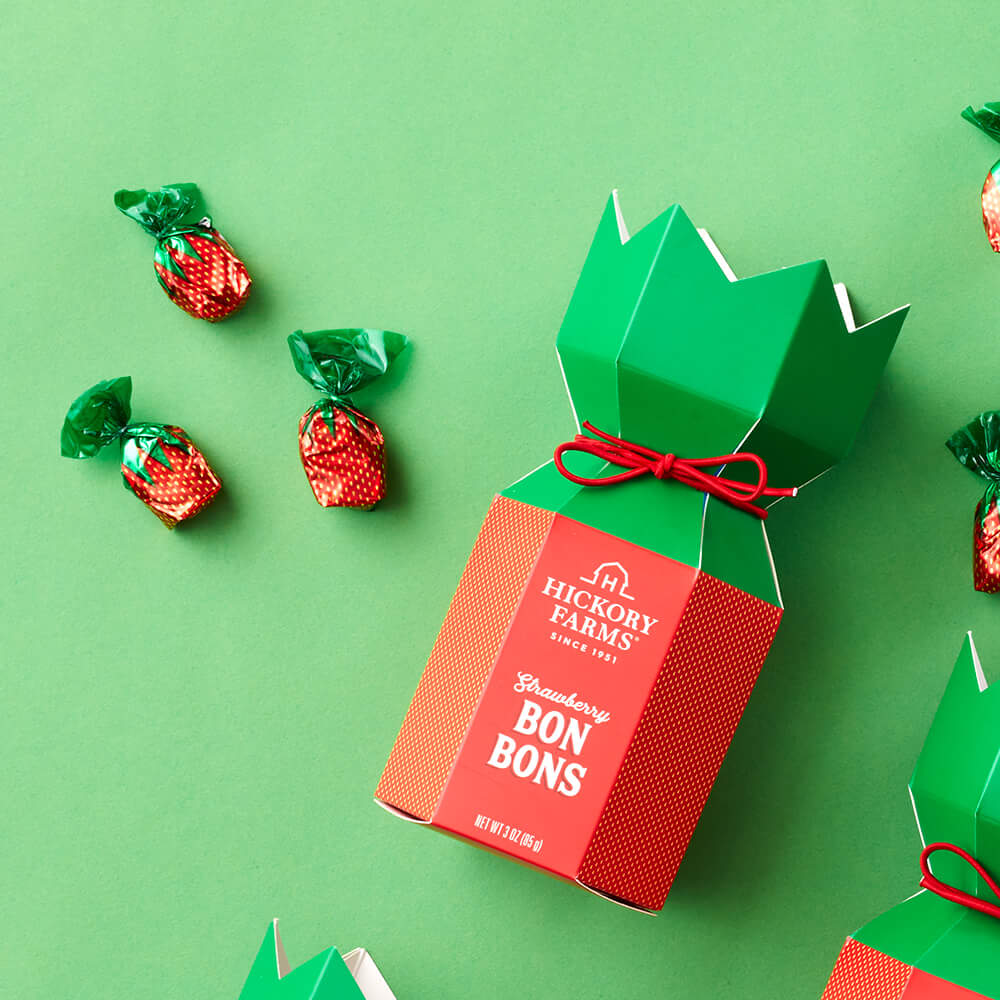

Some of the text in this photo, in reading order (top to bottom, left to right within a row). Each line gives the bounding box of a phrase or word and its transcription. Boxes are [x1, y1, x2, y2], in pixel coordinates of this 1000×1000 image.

[542, 576, 658, 635] HICKORY
[550, 632, 617, 664] SINCE 1951
[513, 671, 610, 724] Strawberry
[513, 699, 592, 755] BON
[487, 733, 587, 797] BONS
[474, 814, 491, 830] NET
[490, 820, 504, 835] WT
[502, 825, 510, 838] 3
[509, 828, 522, 843] OZ
[520, 832, 535, 848] (85
